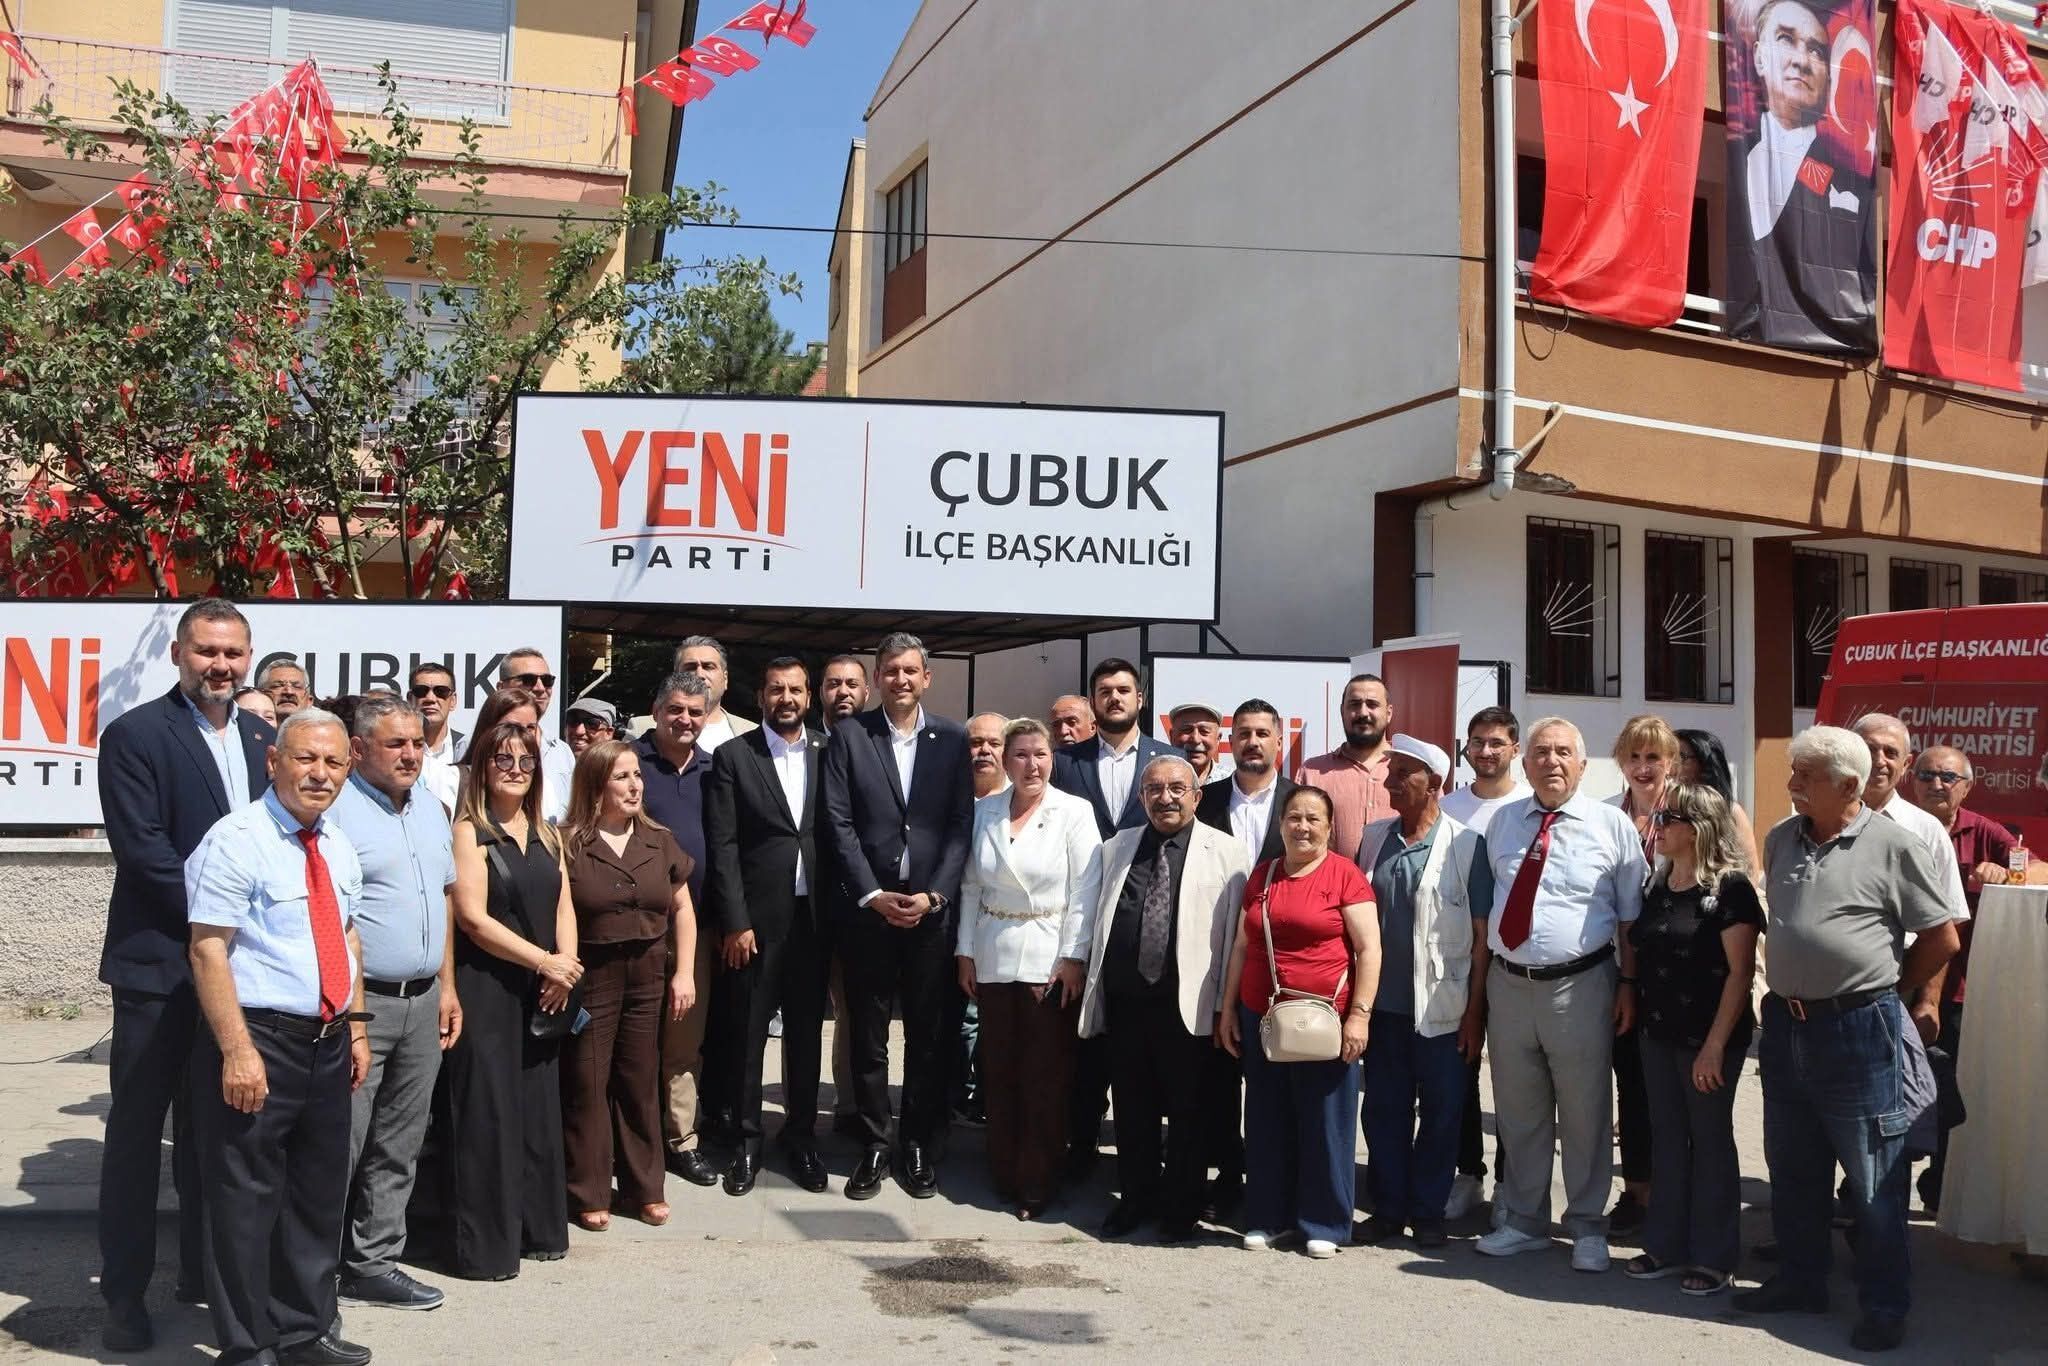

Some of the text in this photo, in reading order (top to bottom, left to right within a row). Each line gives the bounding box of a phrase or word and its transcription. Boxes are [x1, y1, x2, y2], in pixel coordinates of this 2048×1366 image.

[1916, 218, 1997, 269] CHP
[929, 450, 1169, 518] ÇUBUK
[905, 524, 1192, 569] İLÇE BAŞKANLIĞI
[1845, 644, 1897, 665] ÇUBUK
[1900, 639, 1938, 662] İLÇE
[1909, 729, 2036, 757] ALK PARTİSİ
[1974, 766, 2032, 789] Partisi
